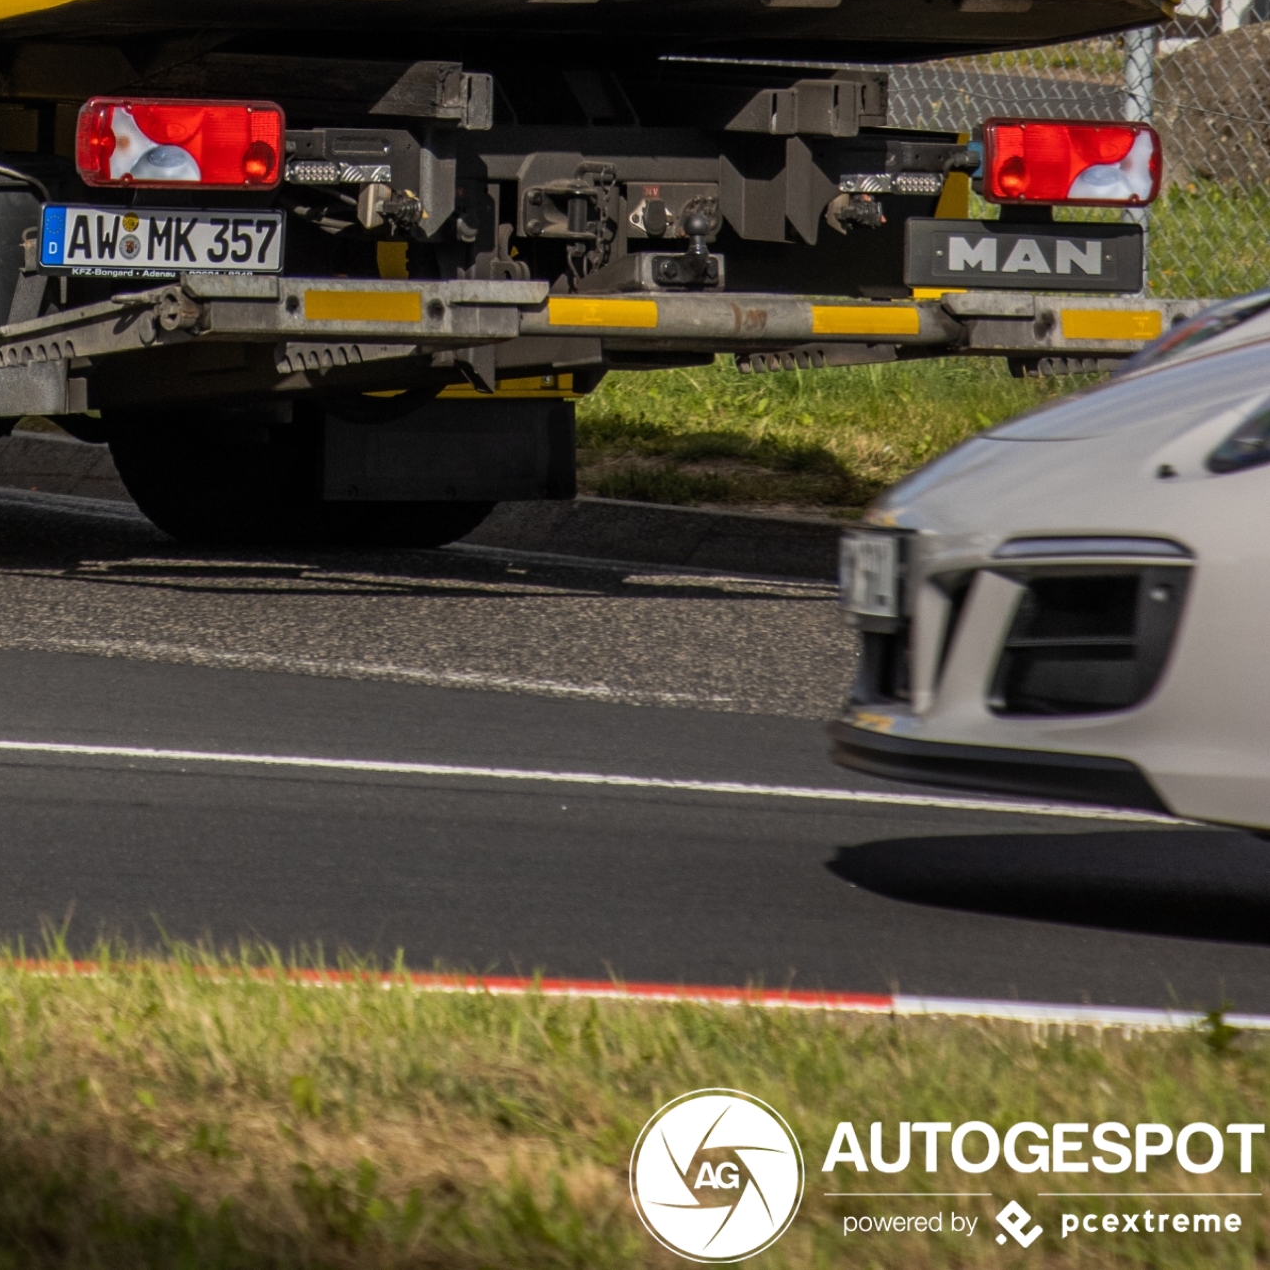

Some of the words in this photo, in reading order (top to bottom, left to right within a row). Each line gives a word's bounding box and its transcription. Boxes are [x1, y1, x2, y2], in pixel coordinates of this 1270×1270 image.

[48, 241, 58, 255] D
[67, 214, 121, 260] AW
[146, 216, 199, 263] MK
[207, 217, 278, 264] 357
[947, 235, 1103, 276] MAN
[71, 267, 134, 278] KFZ-Bongard
[142, 269, 177, 279] Adenau
